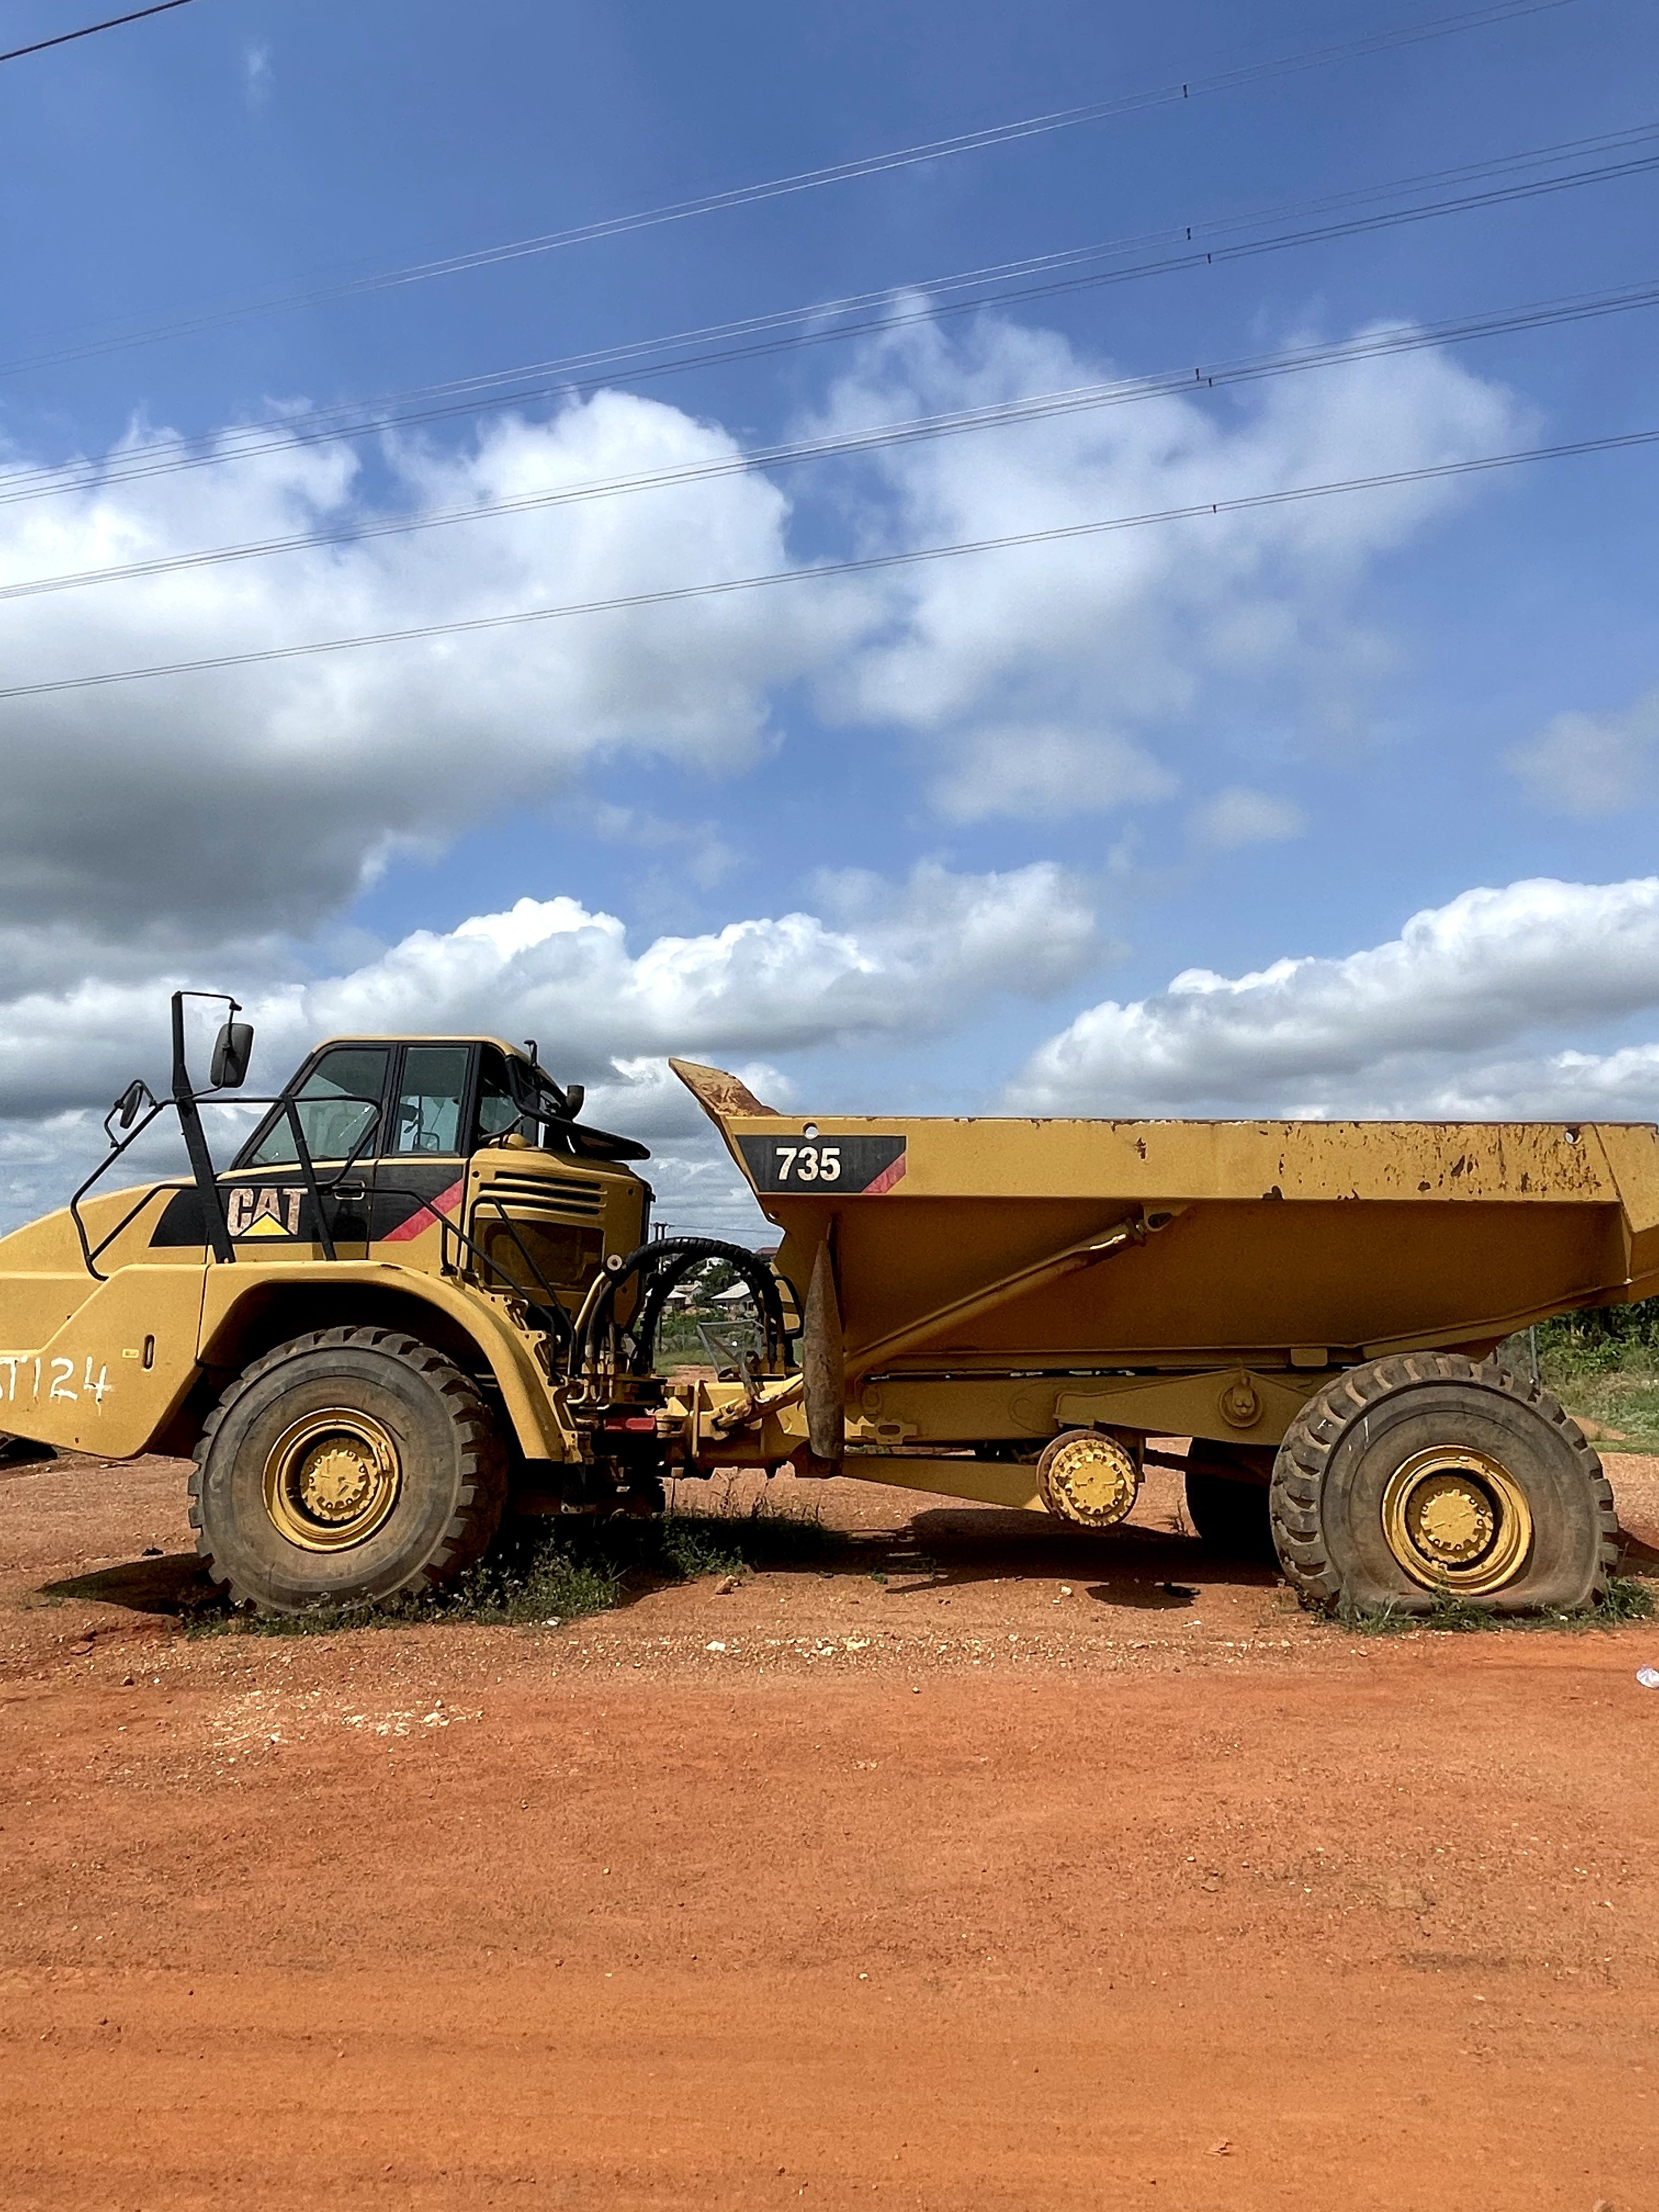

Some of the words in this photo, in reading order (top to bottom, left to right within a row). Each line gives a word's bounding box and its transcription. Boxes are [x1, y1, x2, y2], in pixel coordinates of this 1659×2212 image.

[776, 1147, 840, 1181] 735
[227, 1188, 308, 1236] CAT
[0, 1355, 114, 1405] T124
